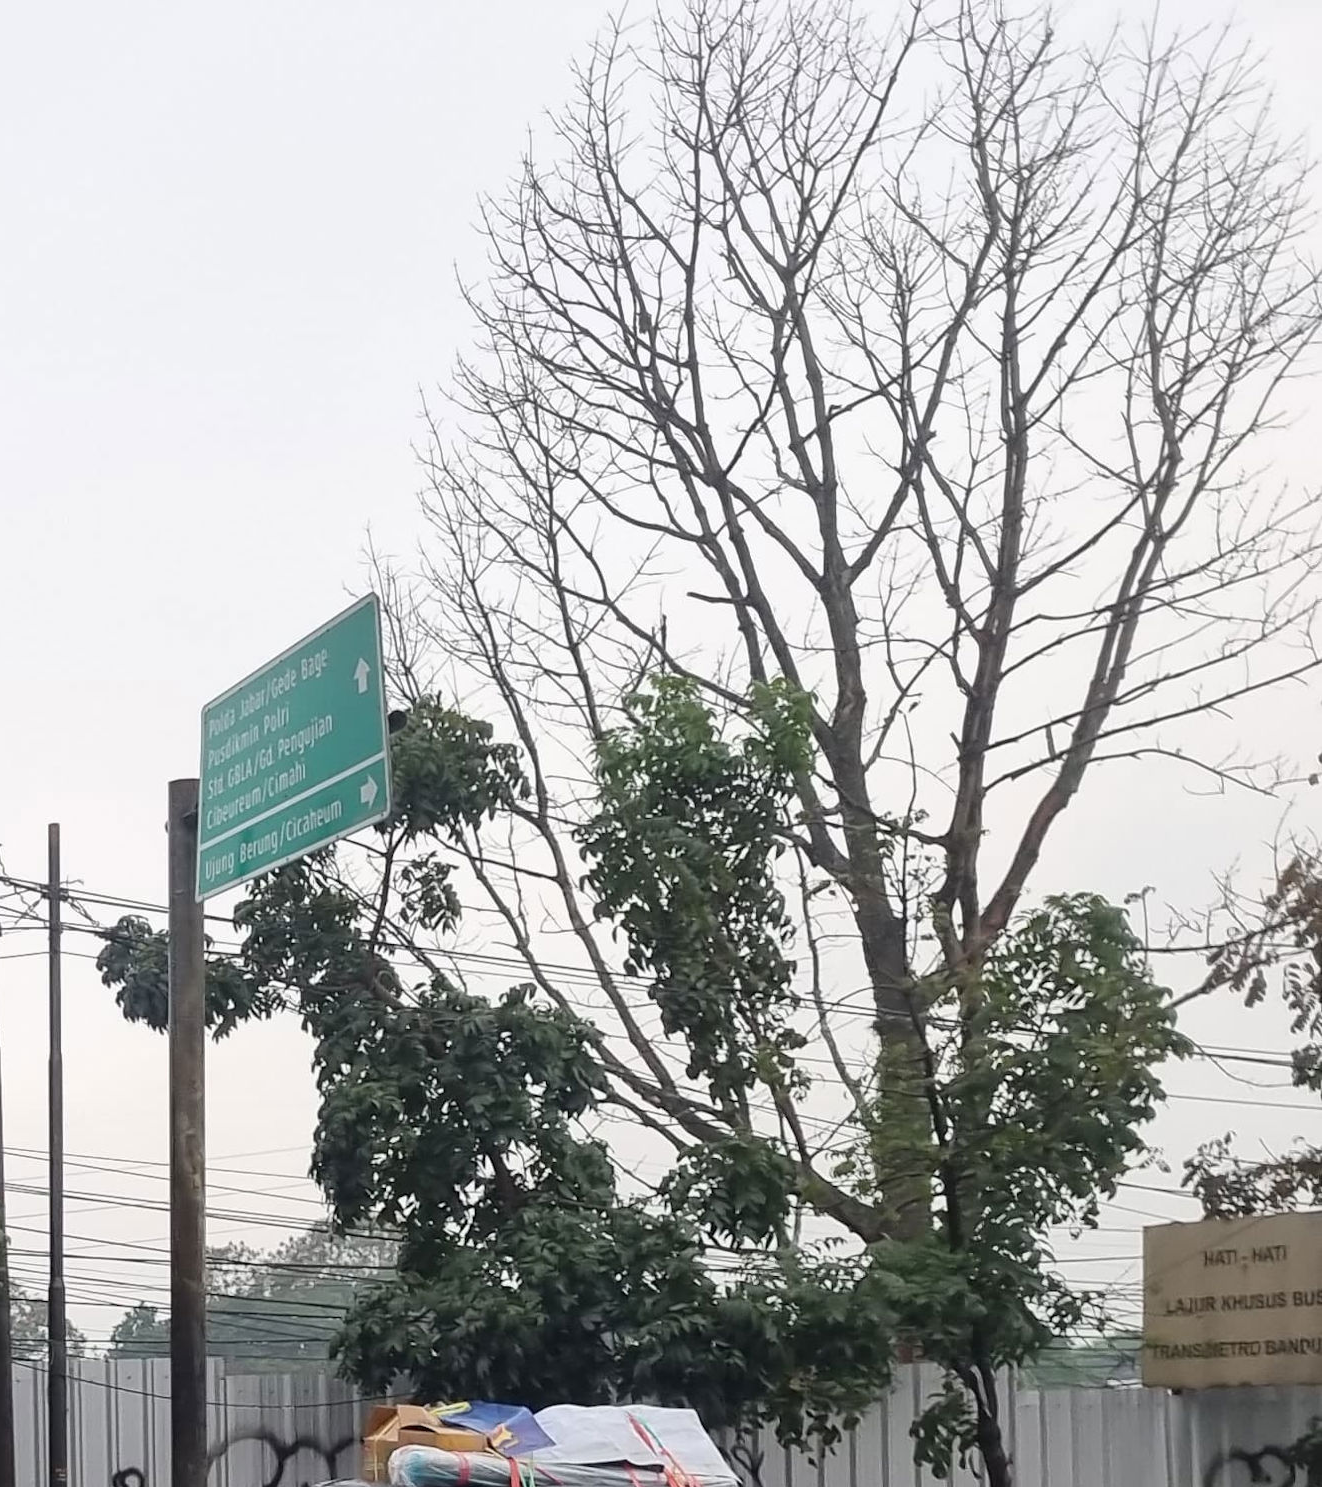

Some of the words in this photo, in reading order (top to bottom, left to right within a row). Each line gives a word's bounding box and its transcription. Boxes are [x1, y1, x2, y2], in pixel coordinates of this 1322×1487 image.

[301, 649, 327, 680] Bage
[207, 723, 259, 770] Pusdikmin
[263, 701, 289, 735] Polri
[277, 714, 332, 760] Pengujian
[206, 758, 306, 830] Cibeureum/Cimahi
[205, 852, 235, 881] Ujung
[1204, 1250, 1237, 1267] HATI
[1252, 1245, 1288, 1264] HATI
[1166, 1295, 1217, 1315] LAJUR
[1220, 1291, 1287, 1311] KHUSUS
